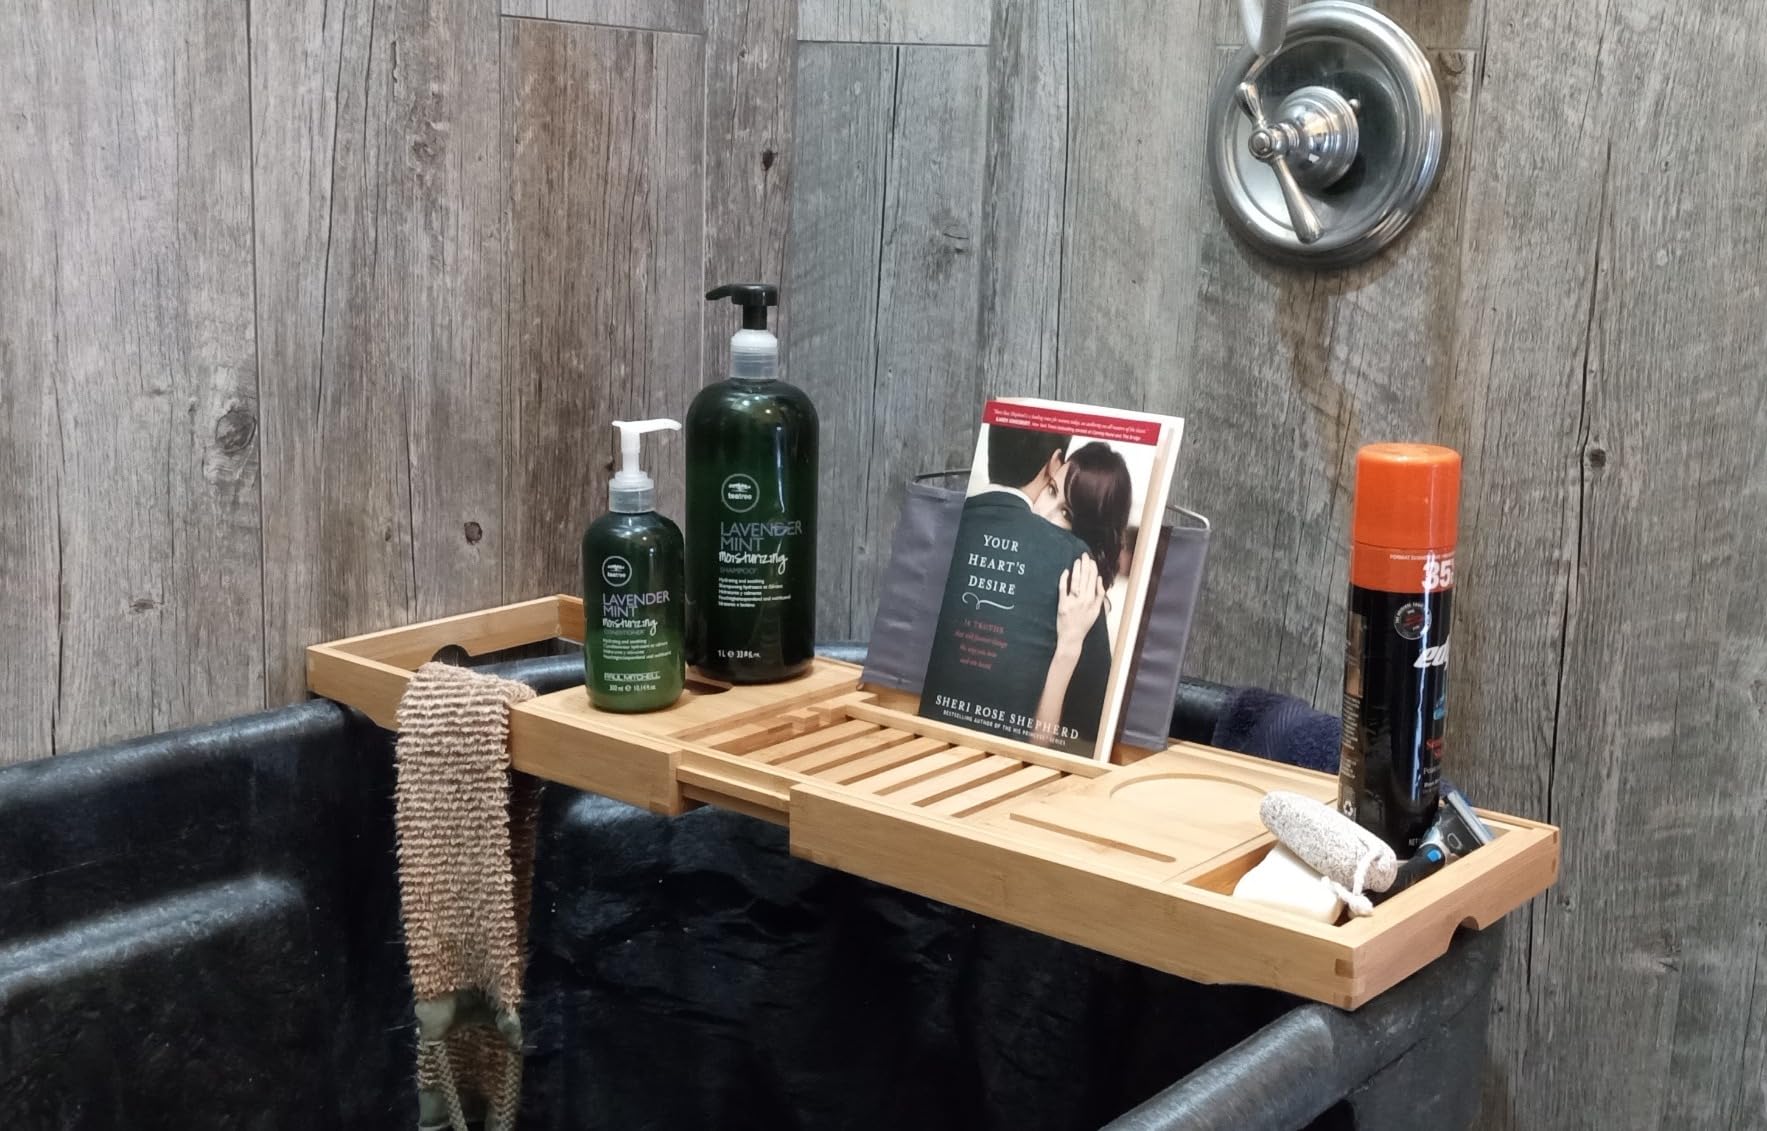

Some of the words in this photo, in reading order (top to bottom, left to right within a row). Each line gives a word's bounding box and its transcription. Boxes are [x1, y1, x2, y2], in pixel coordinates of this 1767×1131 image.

[720, 520, 803, 537] LAVENDER
[720, 536, 765, 552] MINT
[983, 534, 1019, 552] YOUR
[718, 550, 789, 575] moisturizing
[968, 552, 1026, 575] HEART'S
[967, 574, 1016, 595] DESIRE
[602, 590, 670, 606] LAVENDER
[603, 604, 638, 618] MINT
[602, 617, 658, 636] moisturizing
[604, 672, 625, 681] PAUL
[624, 671, 661, 682] MITCHELL
[935, 694, 971, 713] SHERI
[974, 704, 1006, 722] ROSE
[1009, 713, 1079, 740] SHEPHERD
[943, 709, 973, 722] BESTSELLING
[973, 717, 993, 727] AUTHOR
[1002, 724, 1012, 733] THE
